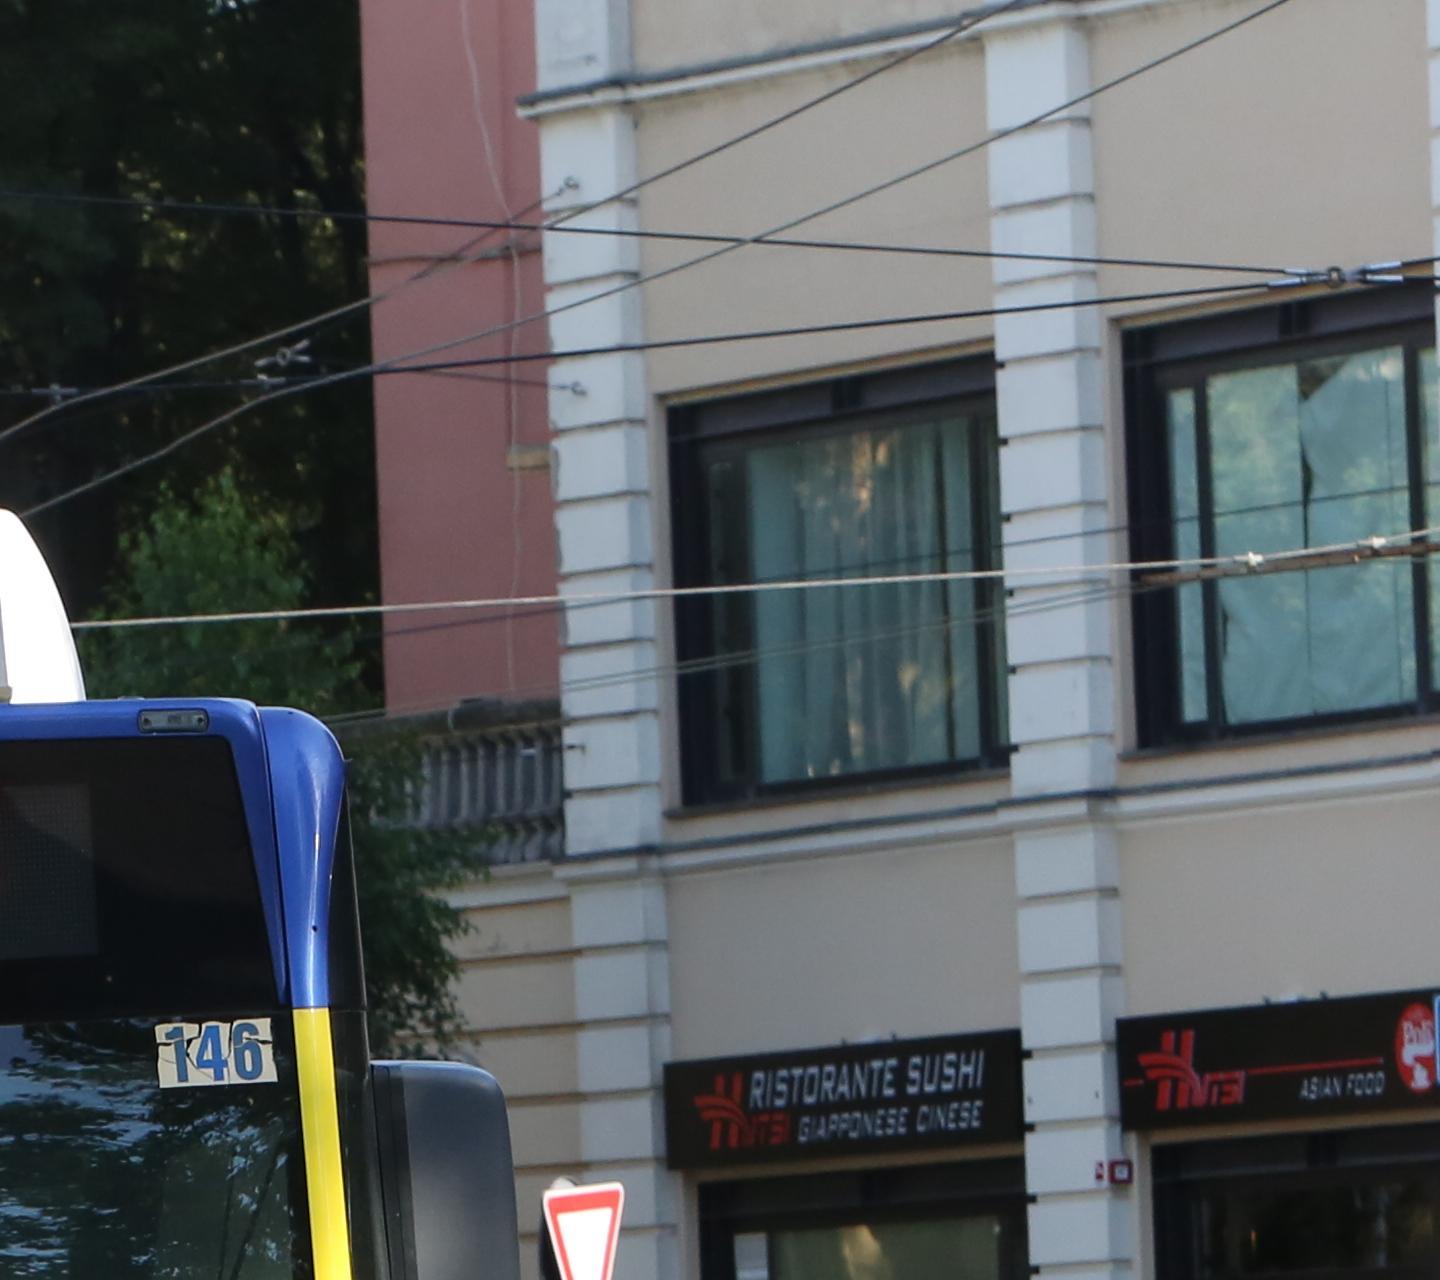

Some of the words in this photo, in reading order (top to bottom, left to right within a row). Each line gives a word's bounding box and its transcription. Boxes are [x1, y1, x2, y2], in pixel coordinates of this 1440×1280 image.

[163, 1022, 264, 1083] 146
[748, 1056, 899, 1110] RISTORANTE
[905, 1049, 986, 1096] SUSHI
[1298, 1073, 1342, 1101] ASIAN
[1346, 1070, 1386, 1097] FOOD
[797, 1106, 910, 1144] GIAPPONESE
[915, 1099, 984, 1133] CINESE
